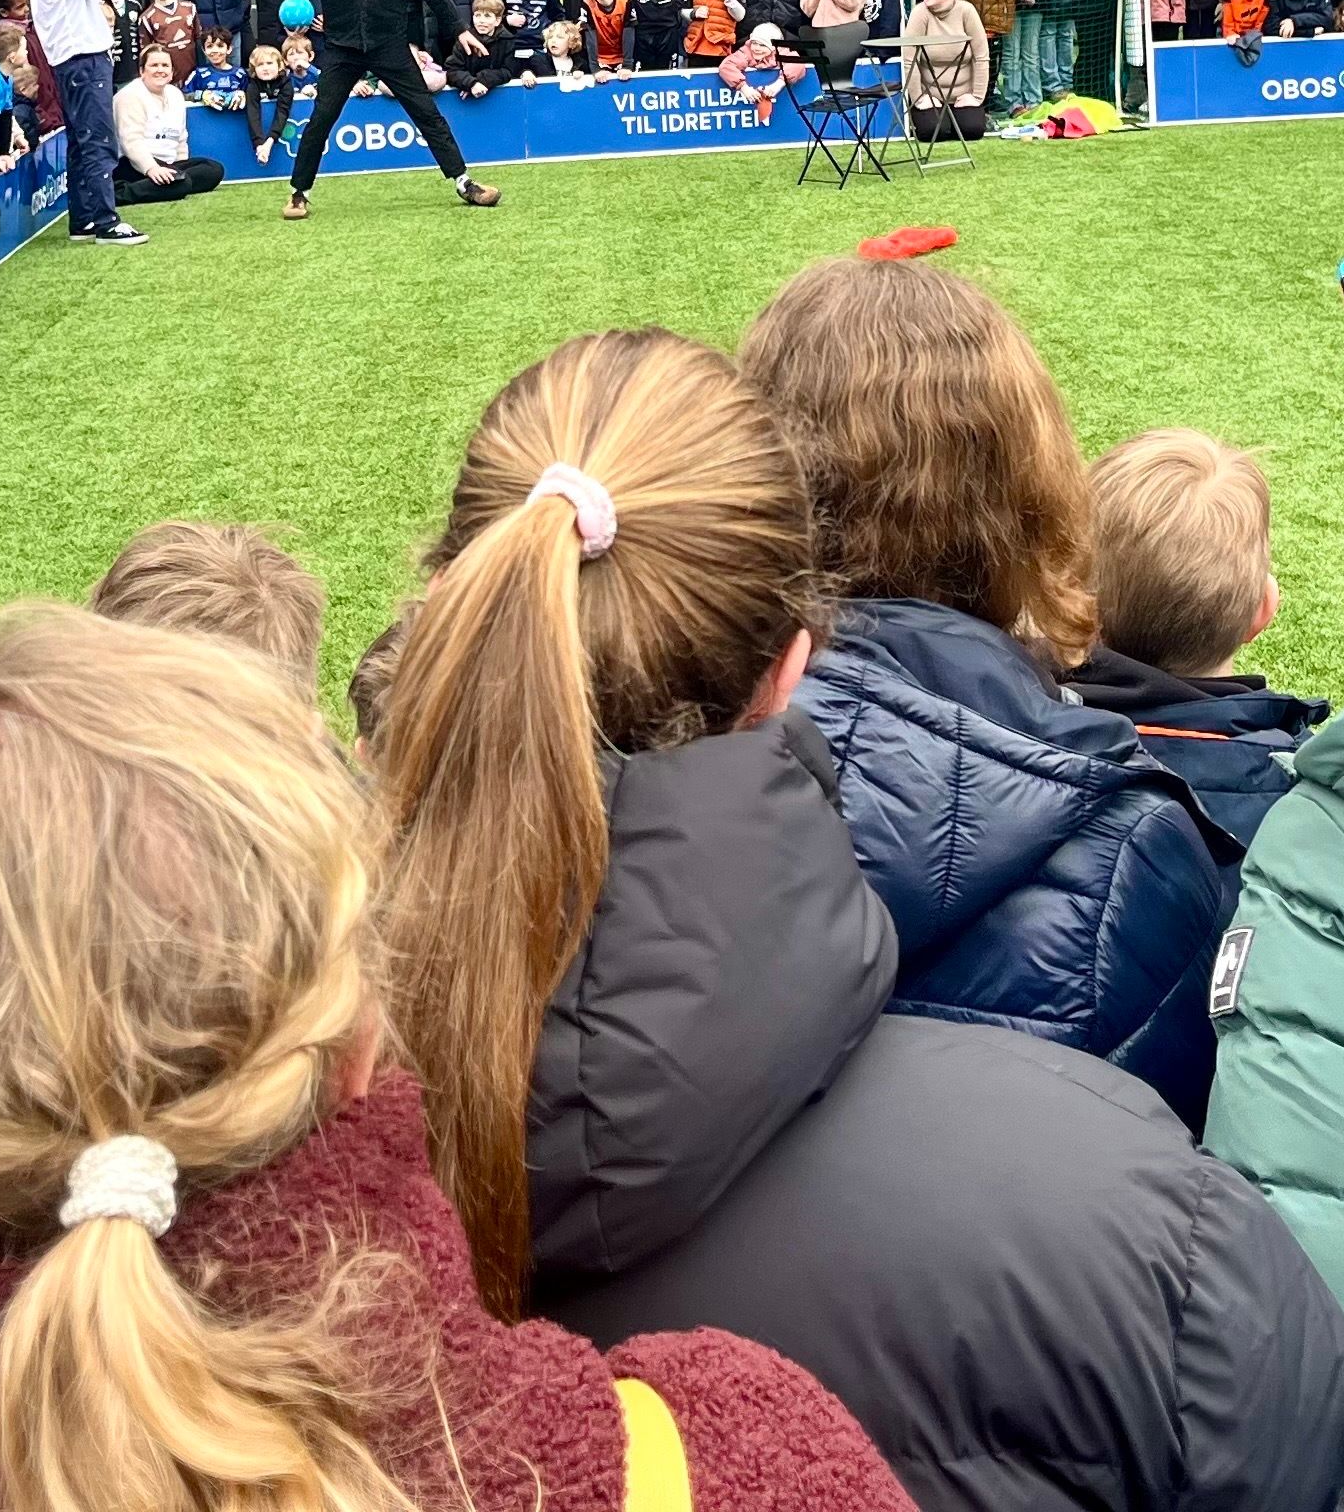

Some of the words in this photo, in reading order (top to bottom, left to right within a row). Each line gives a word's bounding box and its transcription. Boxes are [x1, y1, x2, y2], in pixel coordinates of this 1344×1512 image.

[612, 93, 635, 112] VI
[640, 91, 680, 111] GIR
[684, 88, 777, 108] TILBA
[1261, 77, 1337, 100] OBOS
[621, 115, 656, 135] TIL
